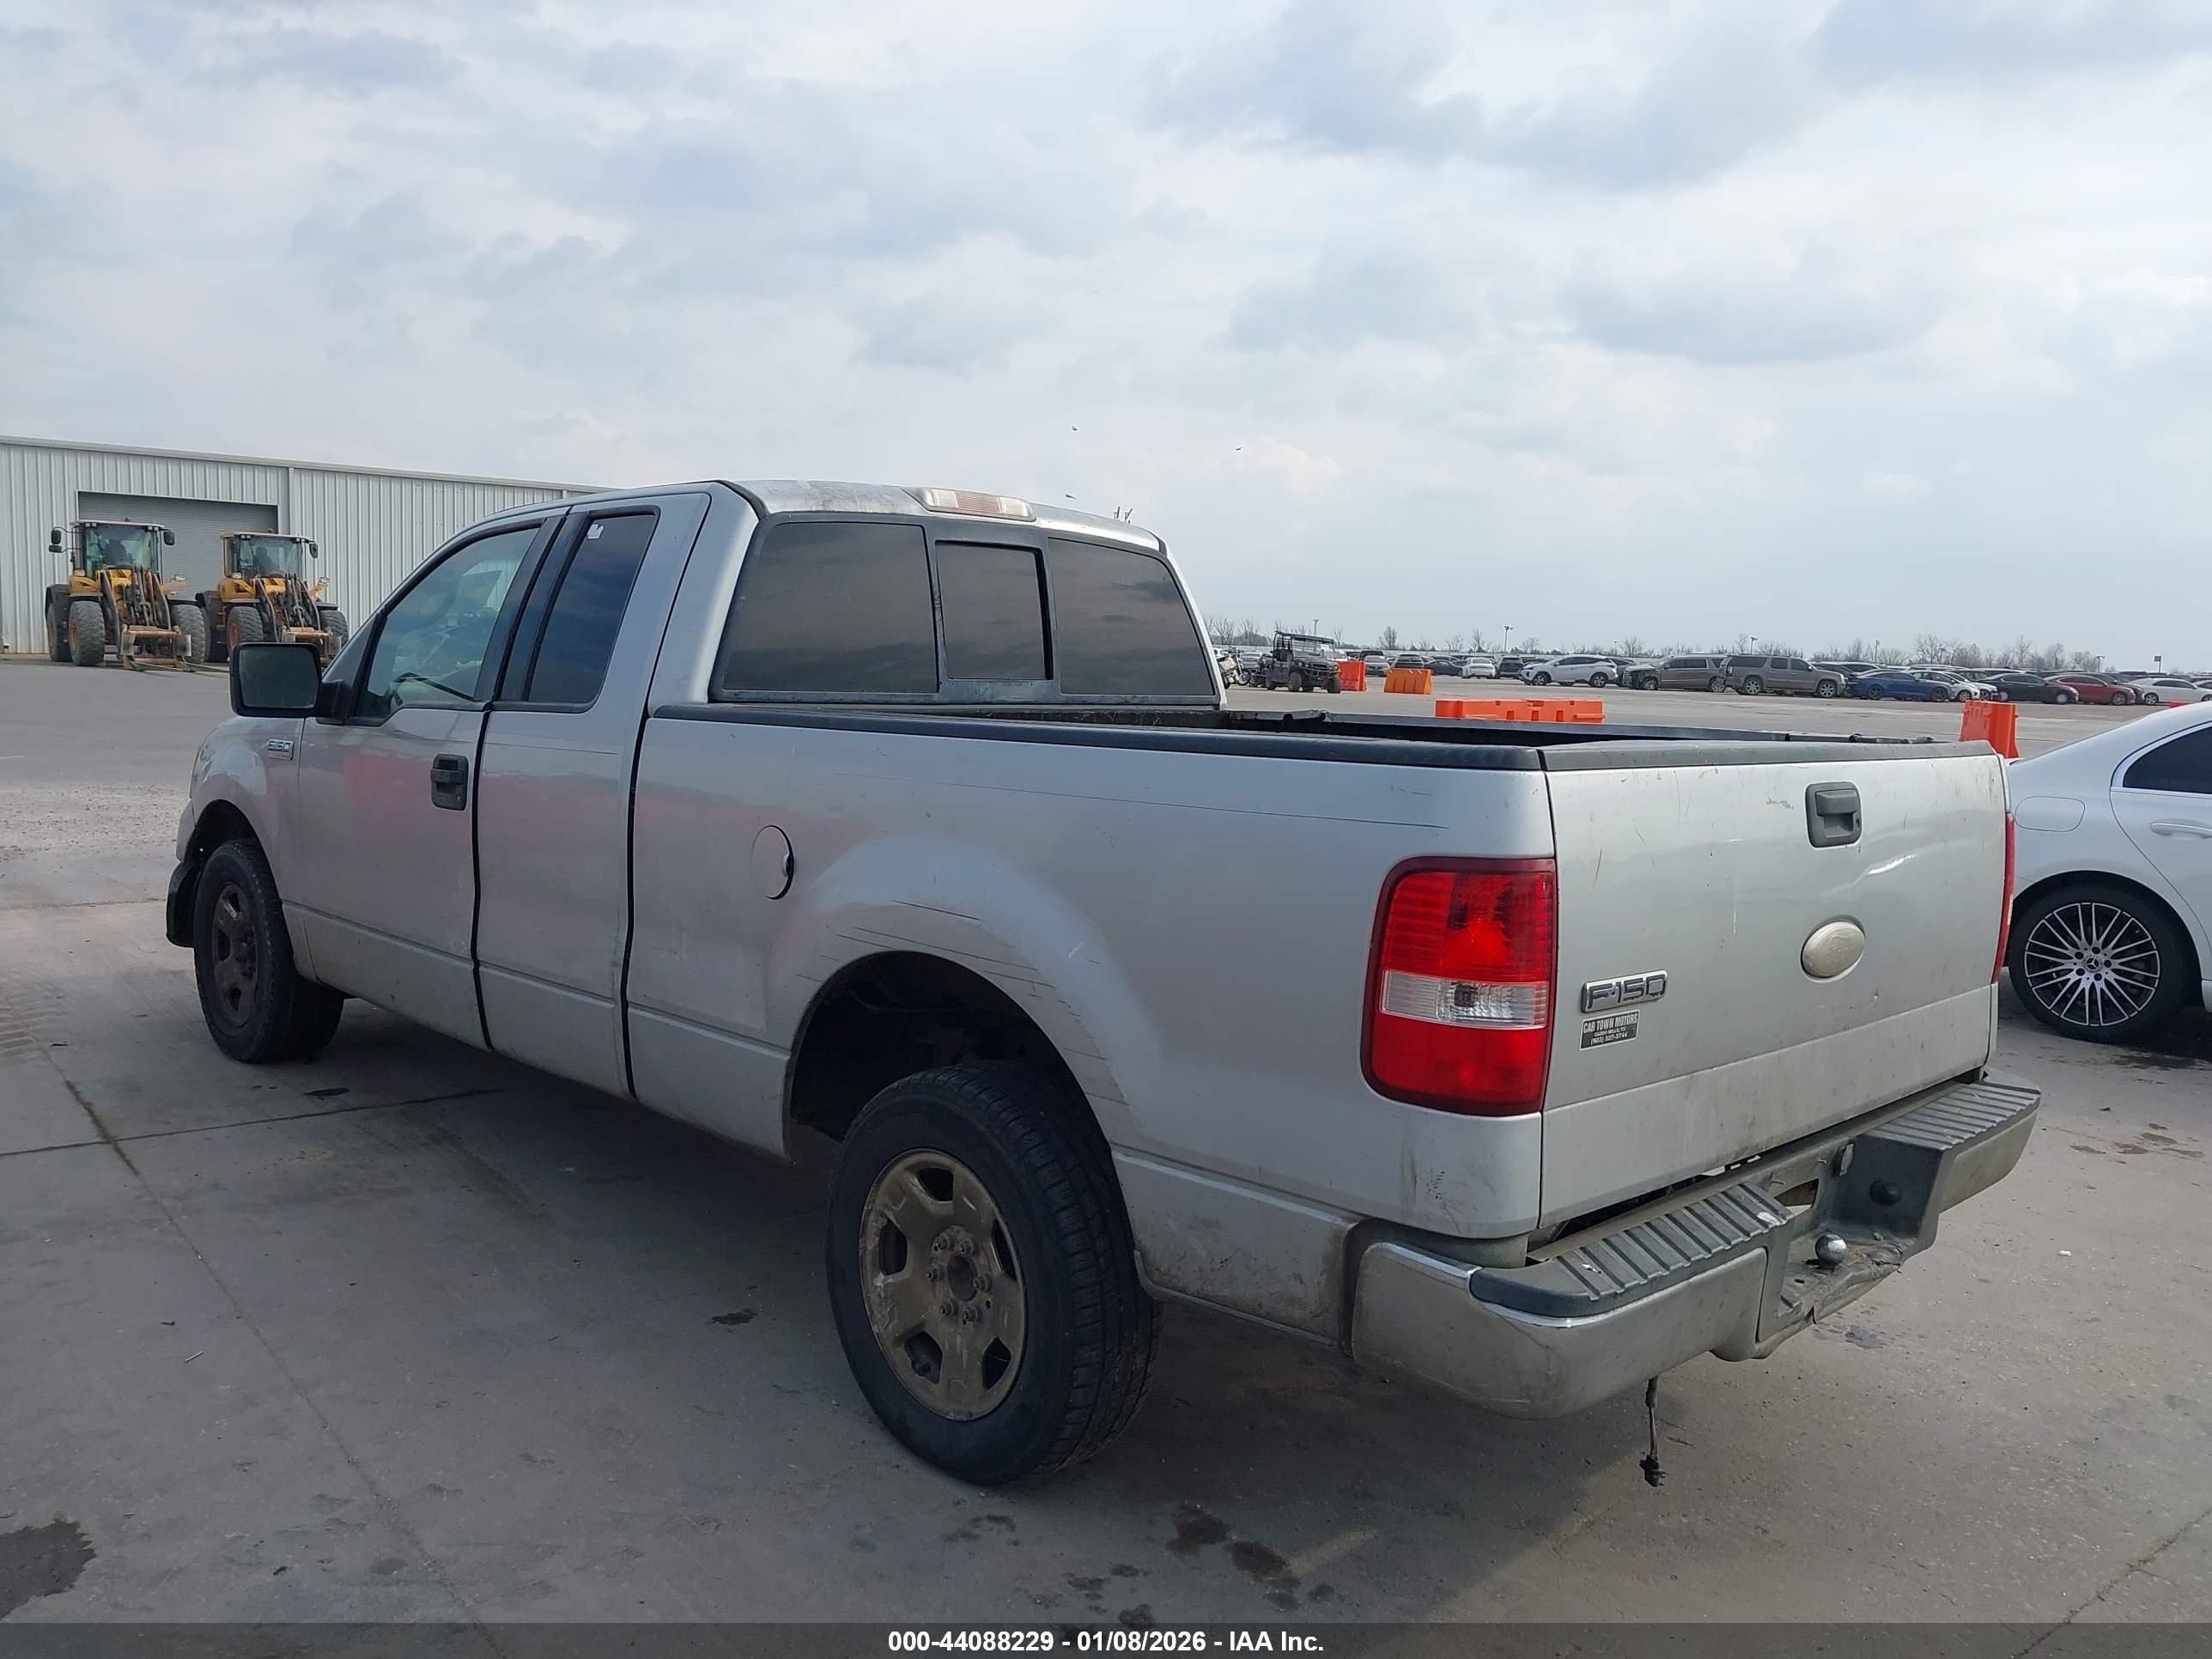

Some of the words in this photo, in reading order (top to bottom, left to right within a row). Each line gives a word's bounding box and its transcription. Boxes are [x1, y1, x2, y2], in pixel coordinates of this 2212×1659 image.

[1583, 1022, 1595, 1033] CAR
[1596, 1018, 1614, 1031] TOWN
[1614, 1013, 1638, 1028] MOTORS
